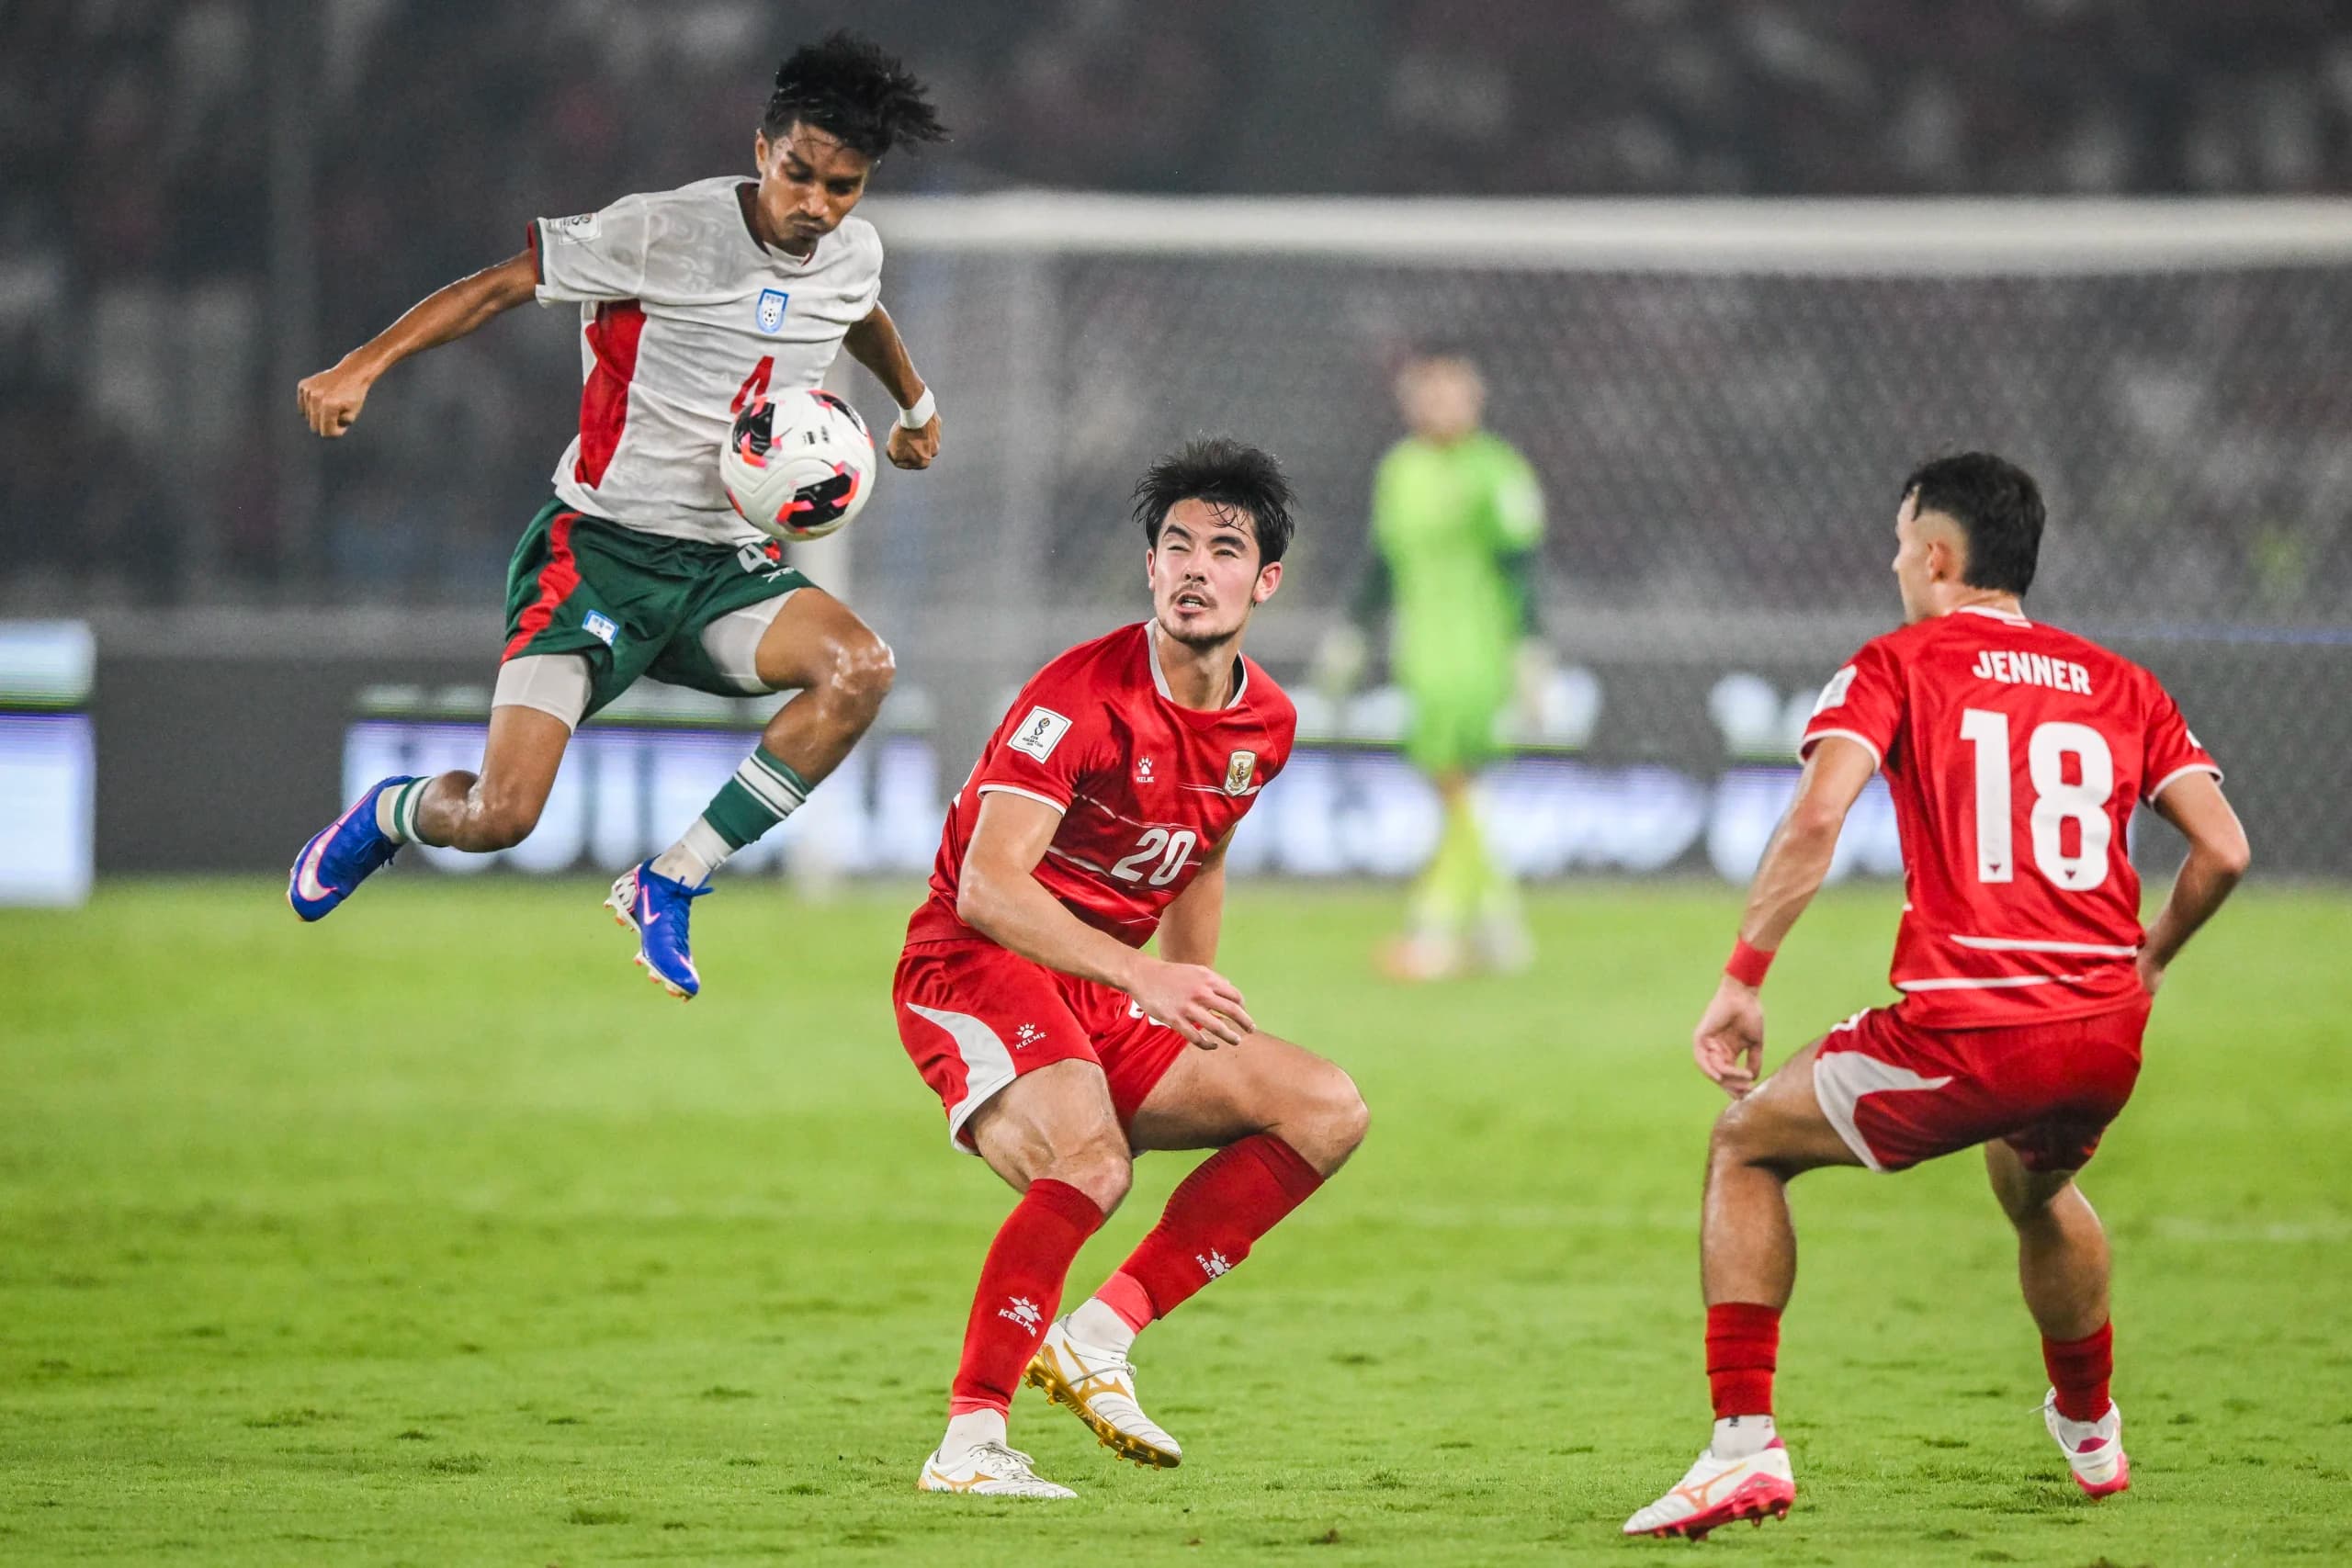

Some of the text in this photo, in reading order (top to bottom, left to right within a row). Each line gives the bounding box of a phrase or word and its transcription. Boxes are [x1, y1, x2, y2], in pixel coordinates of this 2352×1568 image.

[730, 355, 775, 414] 4
[737, 543, 778, 573] 4
[1972, 650, 2093, 696] JENNER
[1960, 708, 2113, 891] 18
[1110, 828, 1197, 886] 20
[1014, 1031, 1047, 1051] KELME
[1195, 1253, 1216, 1280] KEL
